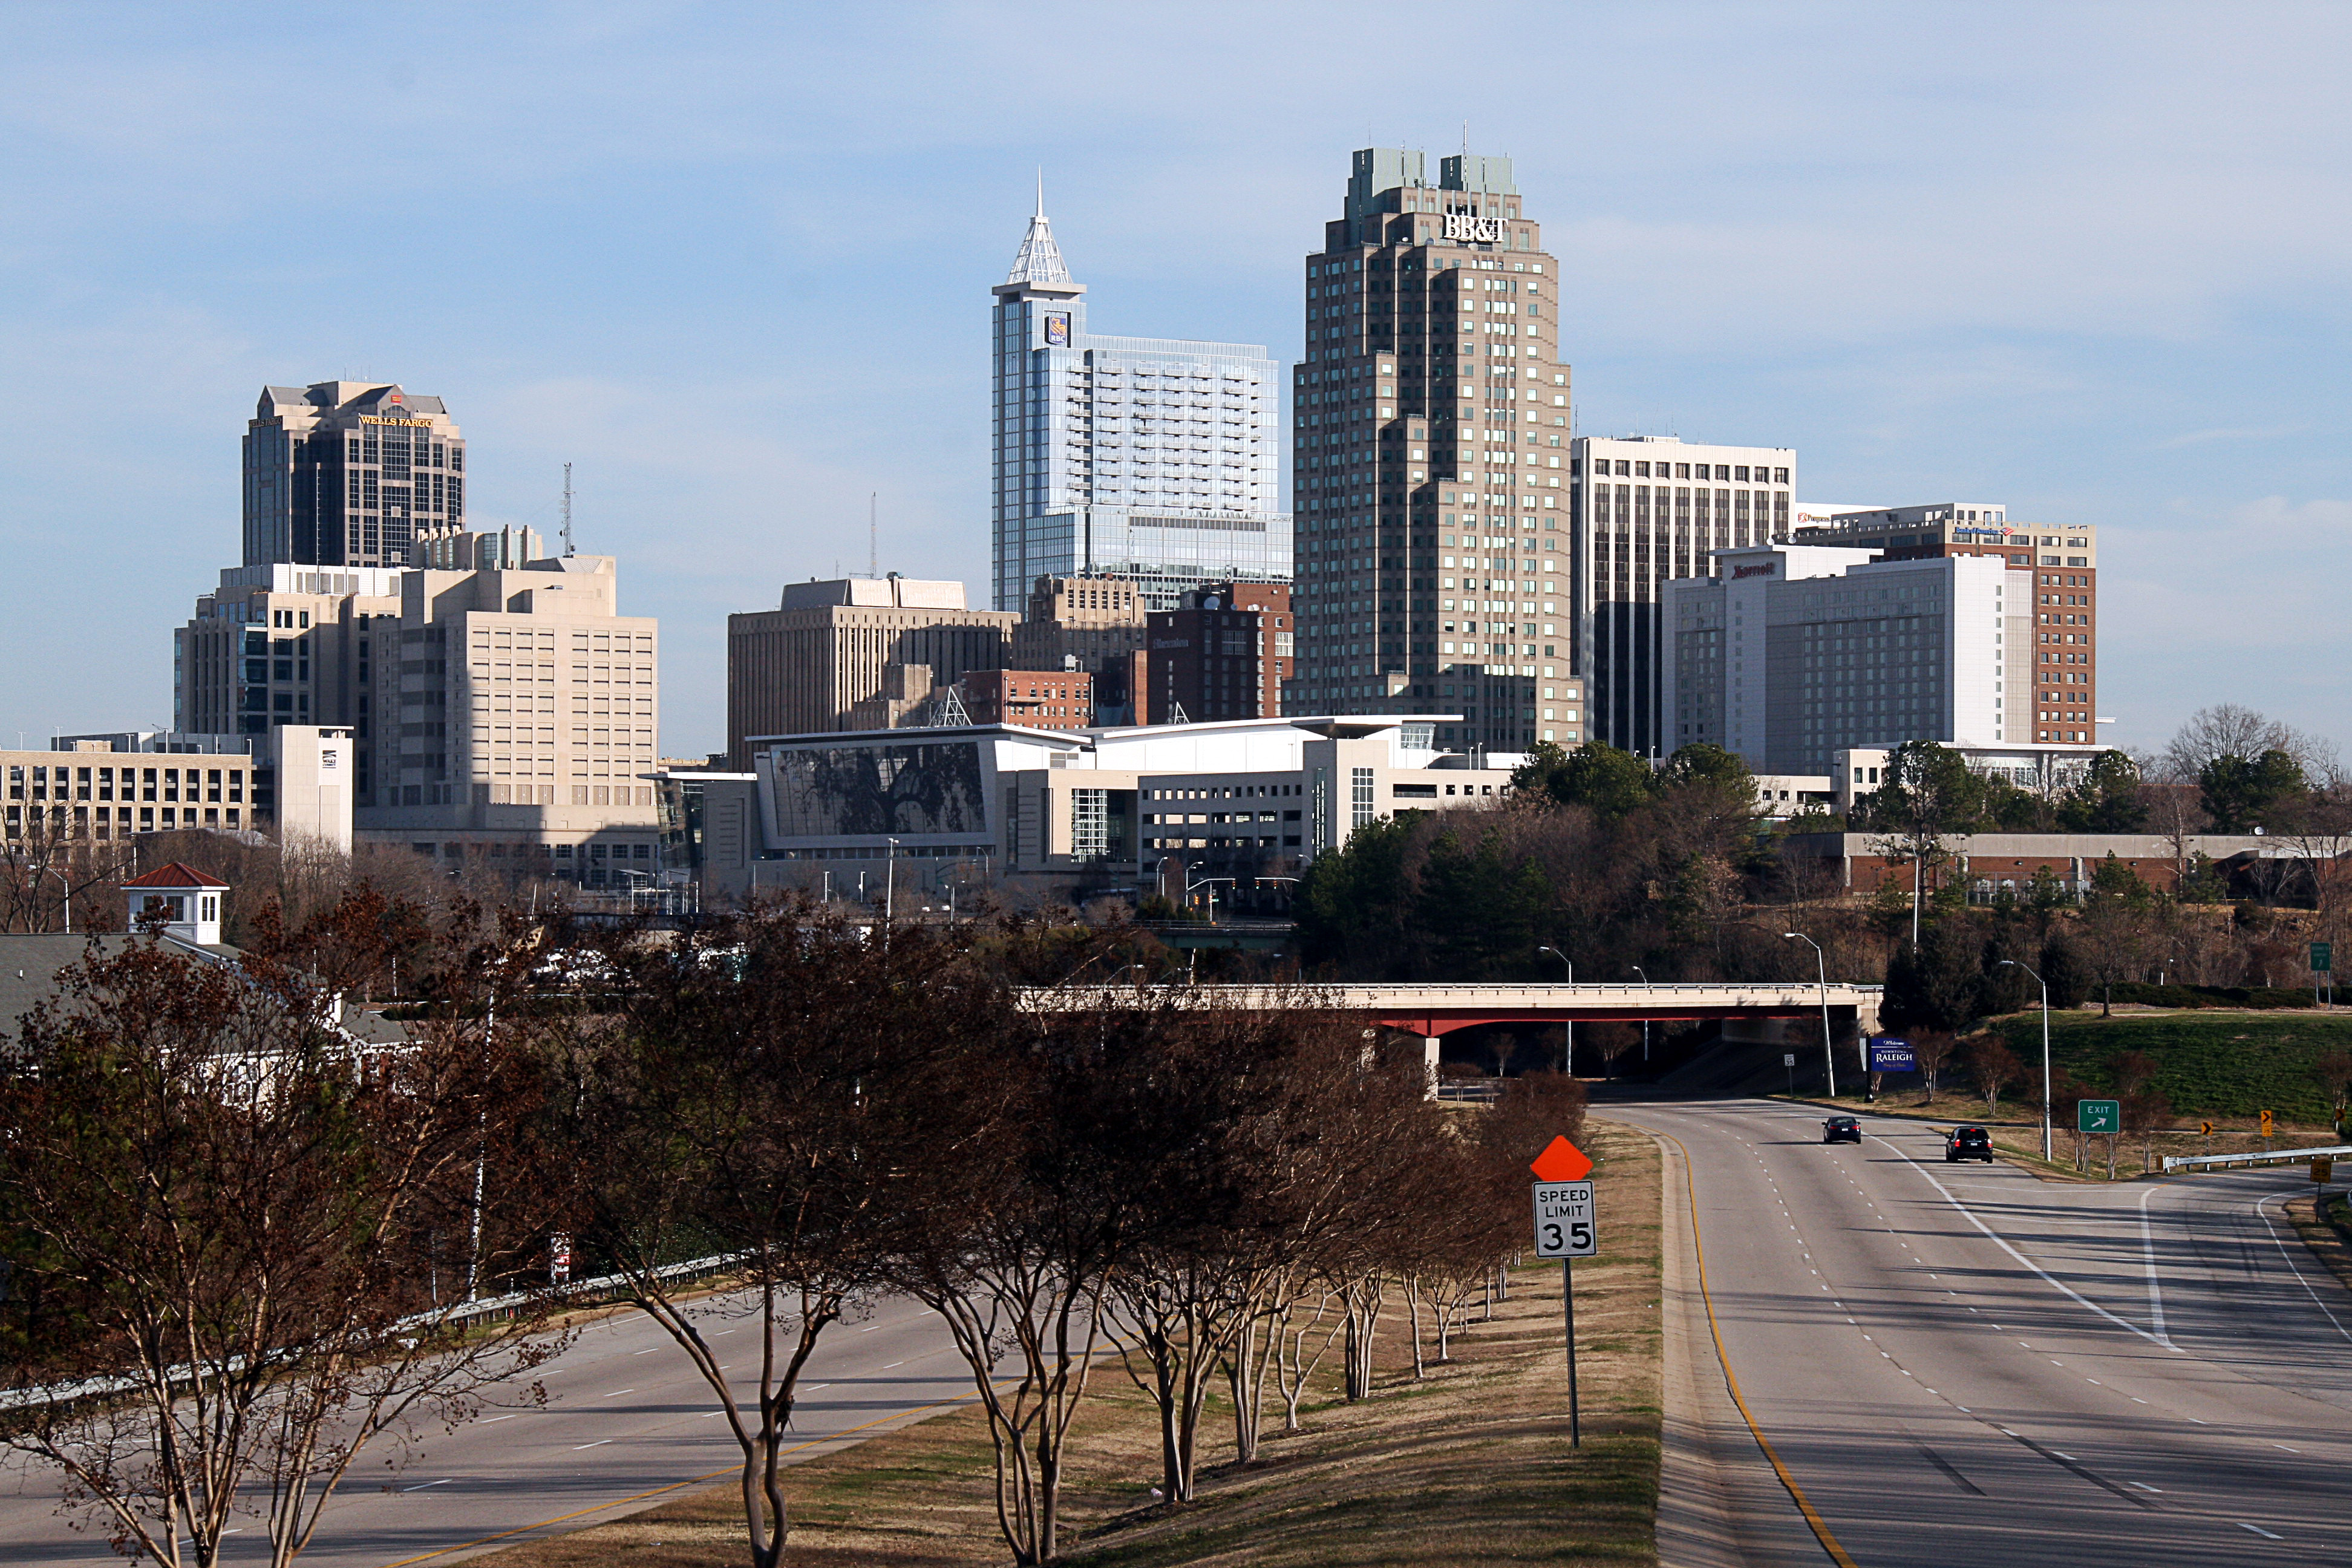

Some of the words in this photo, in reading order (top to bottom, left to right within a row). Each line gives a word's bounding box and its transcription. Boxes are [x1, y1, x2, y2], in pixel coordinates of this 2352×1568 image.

[1444, 214, 1508, 242] BB&T
[266, 417, 282, 426] FARGO
[361, 416, 397, 426] WELLS
[399, 418, 433, 428] FARGO
[1731, 562, 1775, 580] Marriott
[1876, 1053, 1912, 1062] RALEIGH
[2313, 1168, 2328, 1177] 25
[1540, 1190, 1589, 1202] SPEED
[1546, 1205, 1584, 1218] LIMIT
[1543, 1222, 1592, 1251] 35
